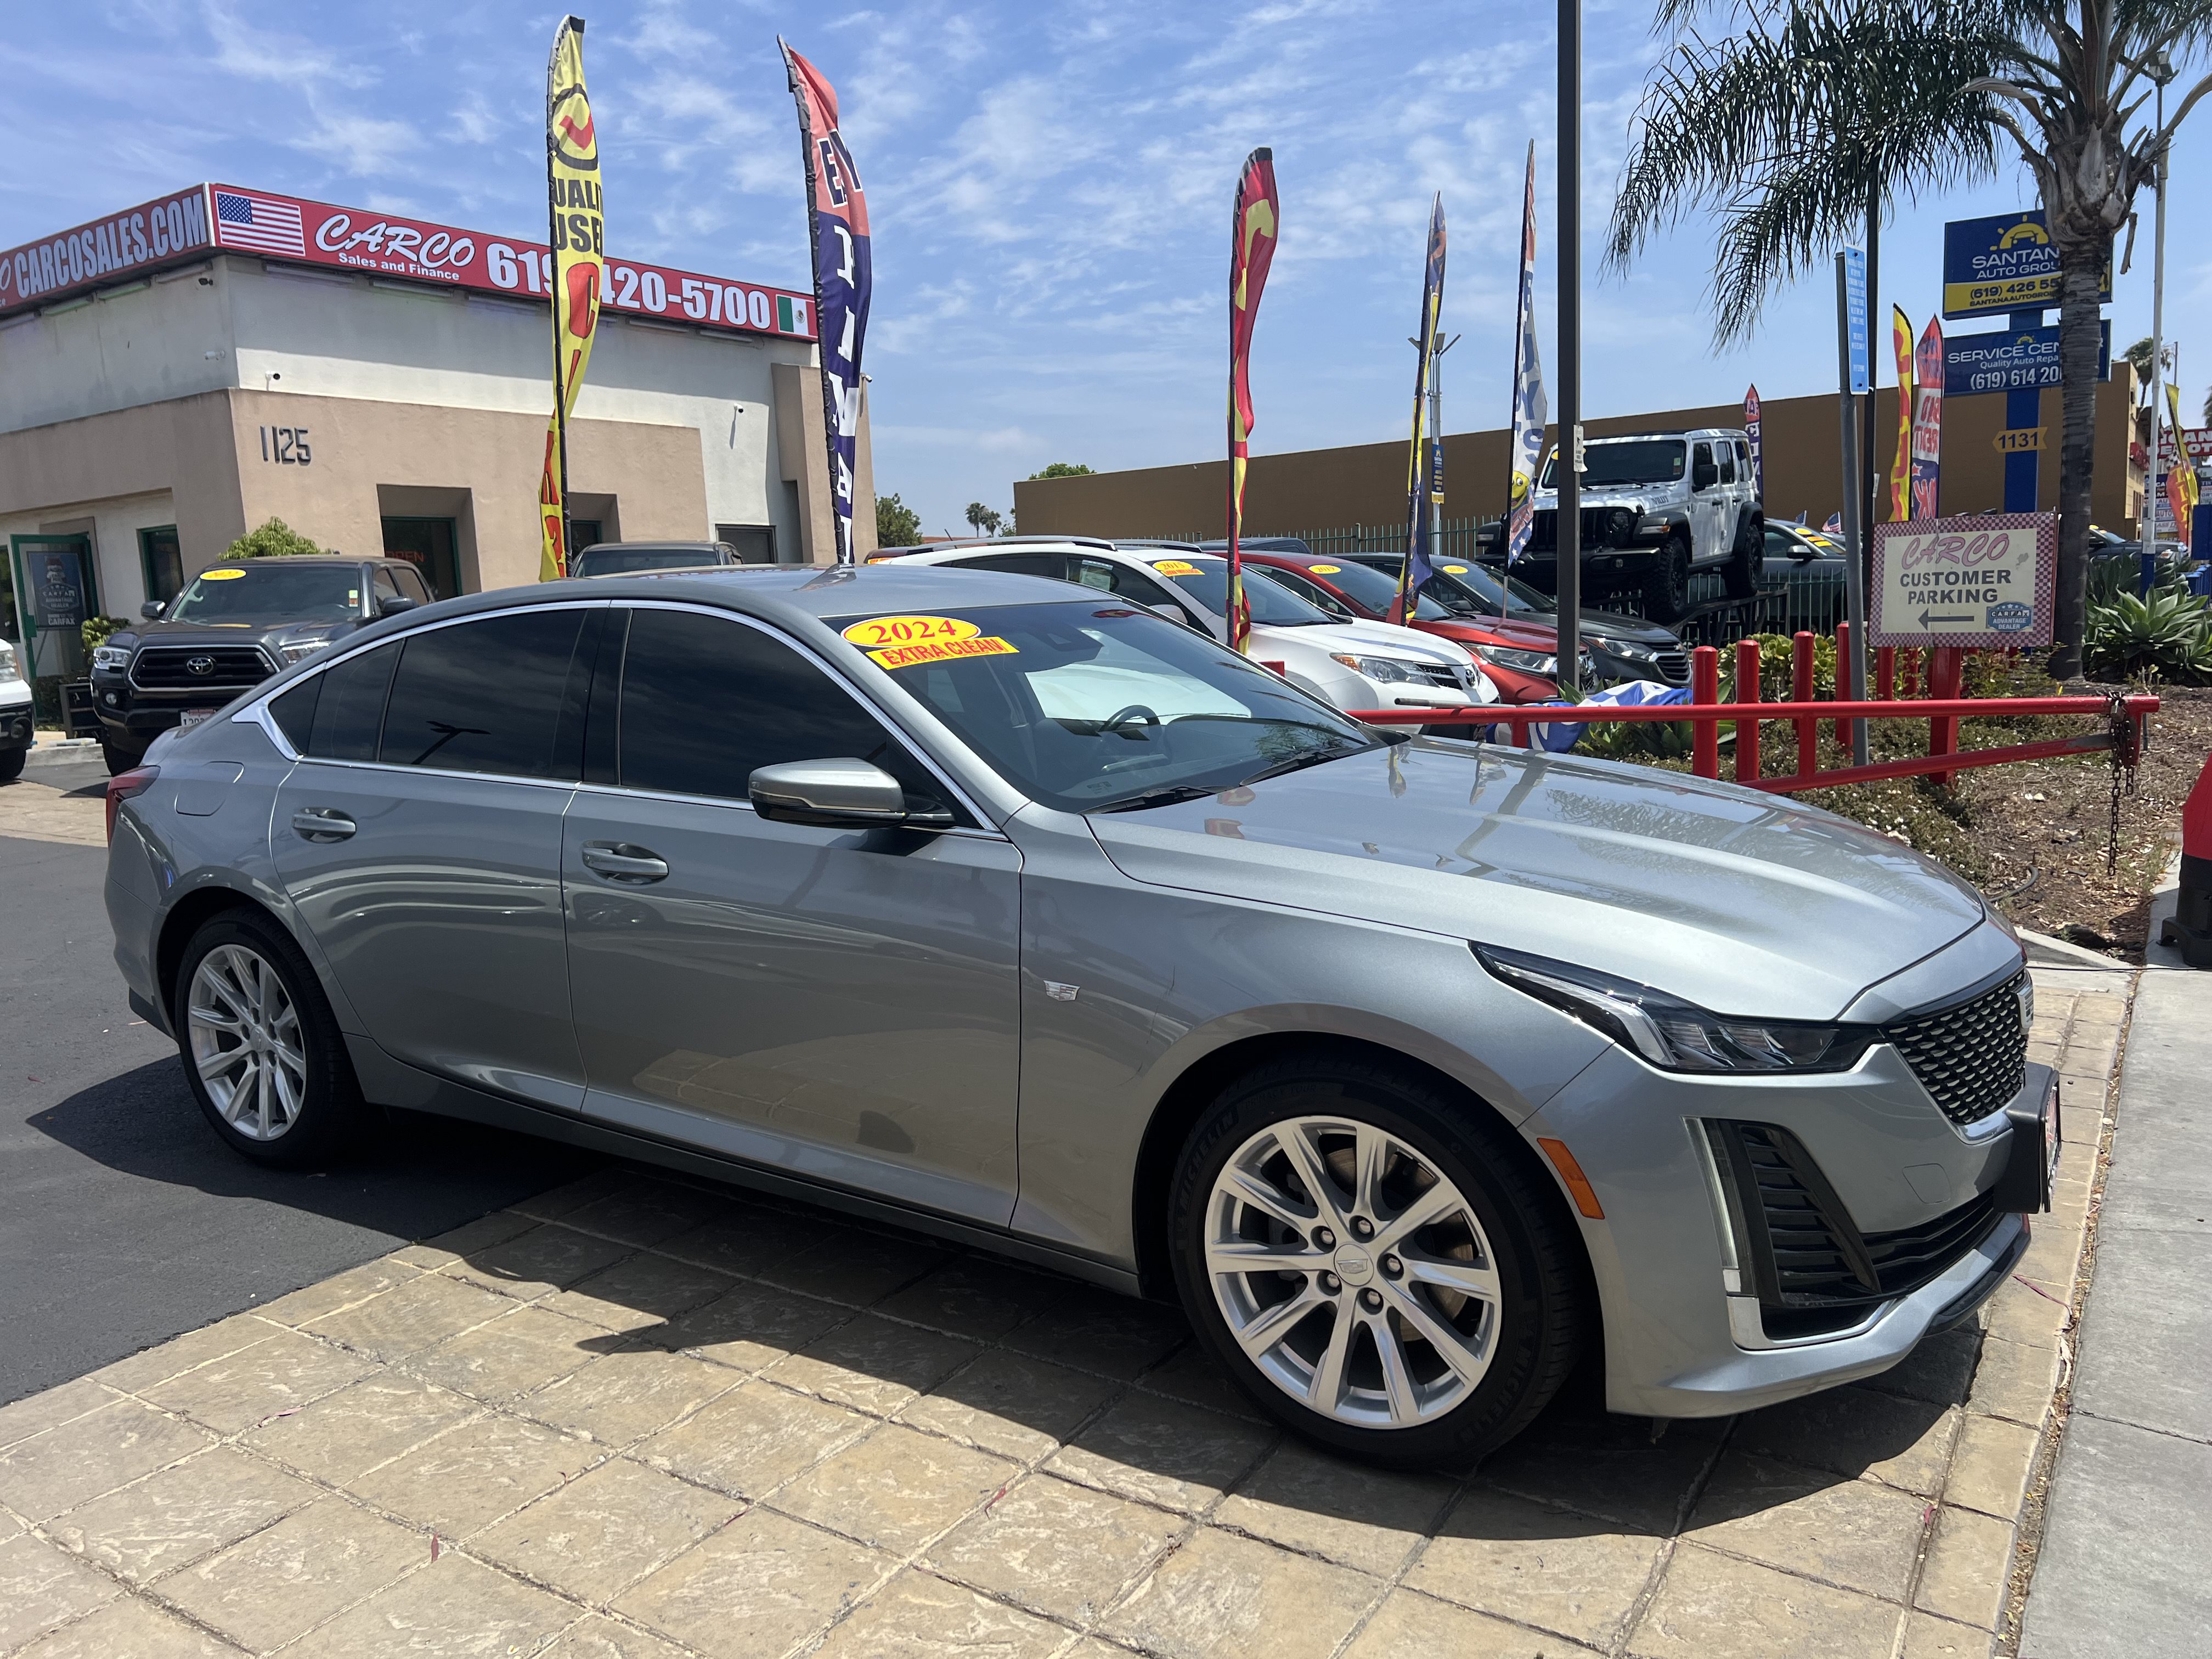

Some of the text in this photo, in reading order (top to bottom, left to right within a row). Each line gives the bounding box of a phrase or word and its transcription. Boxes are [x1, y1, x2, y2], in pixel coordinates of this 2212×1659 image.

[14, 193, 207, 298] CARCOSALES.COM
[315, 213, 476, 268] CARCO
[338, 252, 460, 281] Sales and Finance
[1972, 247, 2059, 269] SANTAN
[1977, 261, 2061, 279] AUTO GROU
[1971, 277, 2058, 300] (619) 426 55
[1948, 345, 2024, 363] SERVICE
[1980, 355, 2058, 369] Quality Auto Repa
[1970, 365, 2062, 390] (619) 614 20
[260, 425, 311, 466] 1125
[1998, 432, 2038, 449] 1131
[1901, 533, 2010, 569] CARCO
[1900, 569, 2011, 587] CUSTOMER
[1908, 588, 1998, 605] PARKING
[868, 620, 956, 644] 2024
[880, 638, 1007, 665] EXTRA CLEAN
